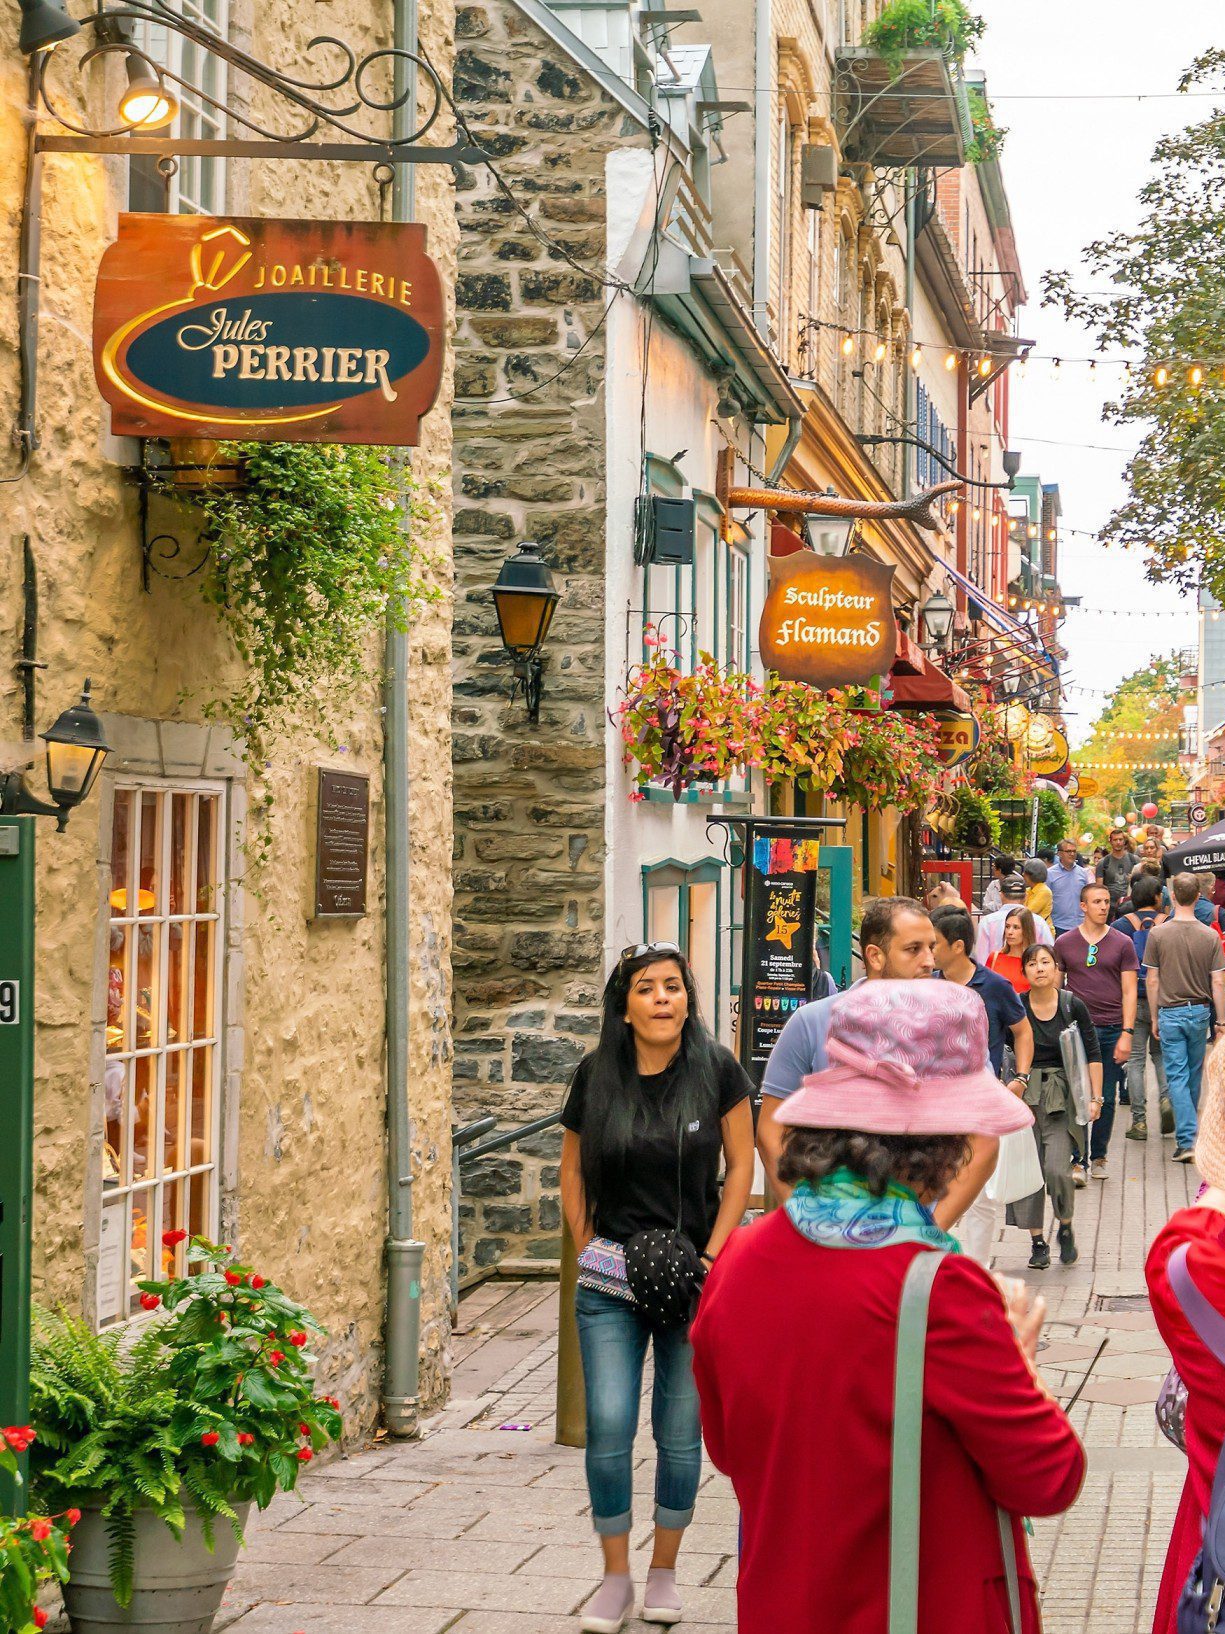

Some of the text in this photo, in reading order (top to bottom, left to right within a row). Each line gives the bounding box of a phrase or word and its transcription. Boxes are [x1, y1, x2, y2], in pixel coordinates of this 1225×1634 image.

[254, 264, 413, 306] JOAILLERIE
[176, 308, 273, 350] Jules
[212, 344, 398, 402] PERRIER
[783, 587, 875, 611] Sculpteur
[776, 618, 881, 648] Flamand
[1183, 853, 1212, 866] CHEVAL
[776, 925, 788, 935] 15
[769, 960, 803, 968] septembre
